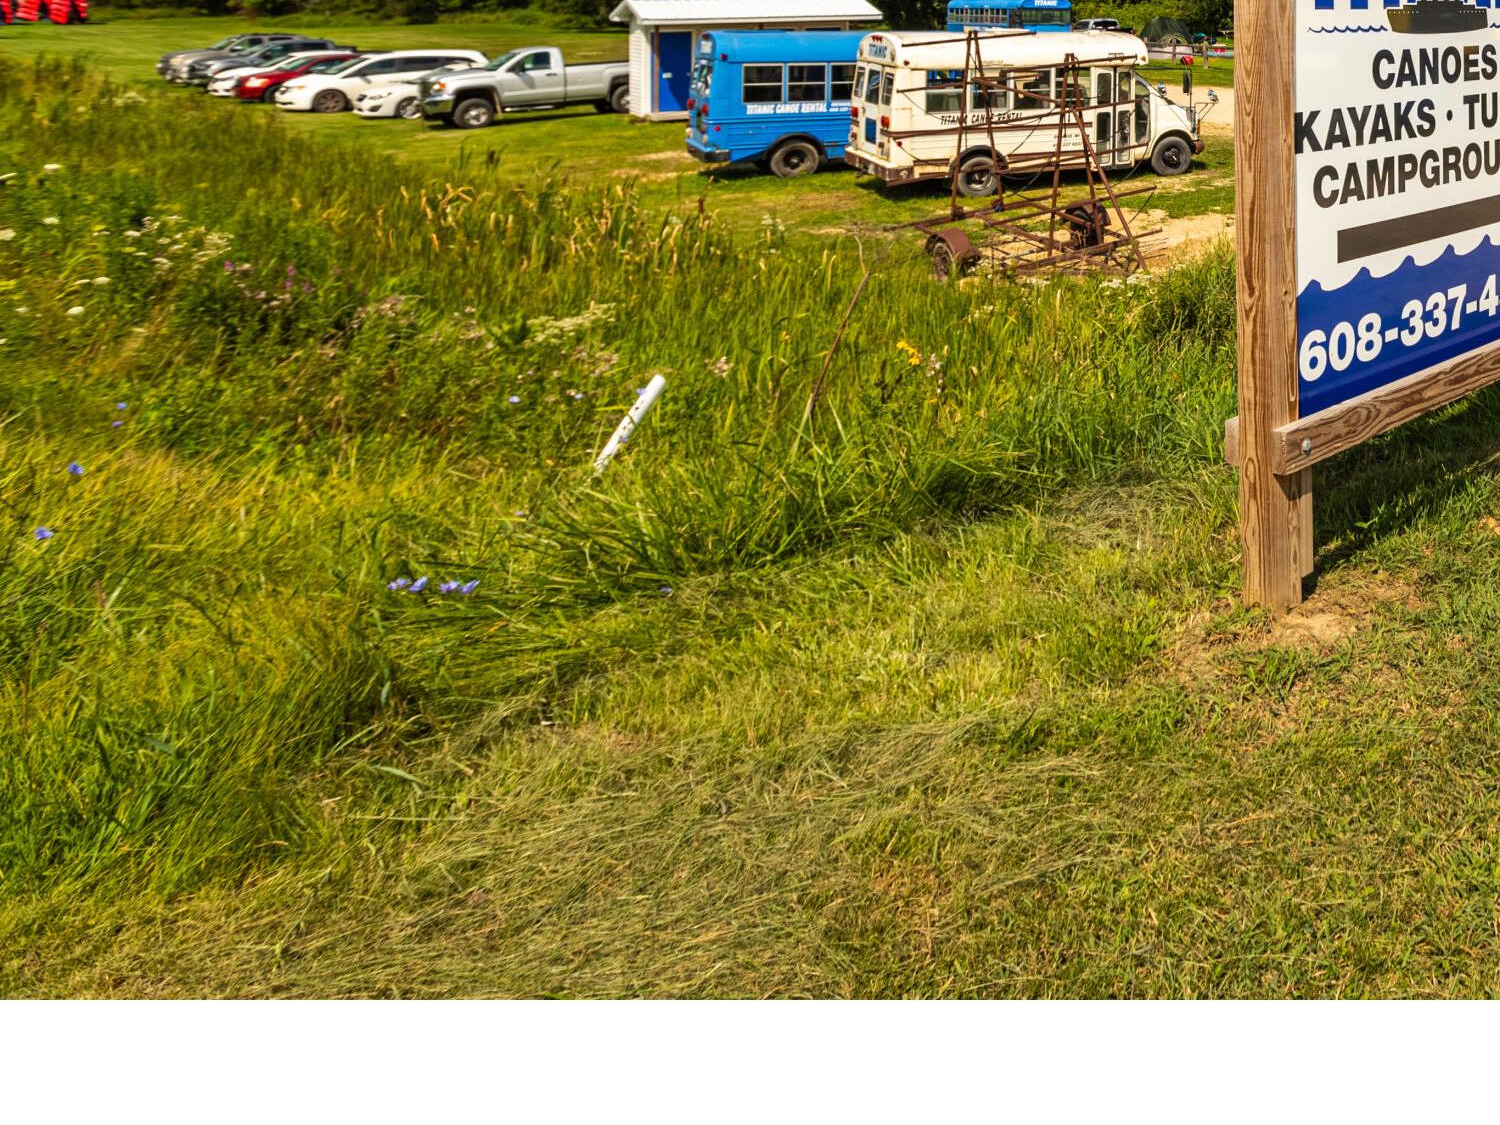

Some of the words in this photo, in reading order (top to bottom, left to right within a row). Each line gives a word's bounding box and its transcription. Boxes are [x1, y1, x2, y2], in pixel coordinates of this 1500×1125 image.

[868, 43, 888, 59] TITANIC
[1372, 43, 1498, 89] CANOES
[746, 104, 775, 115] TITANIC
[776, 103, 800, 114] CANOE
[801, 102, 828, 113] RENTAL
[1294, 98, 1436, 155] KAYAKS
